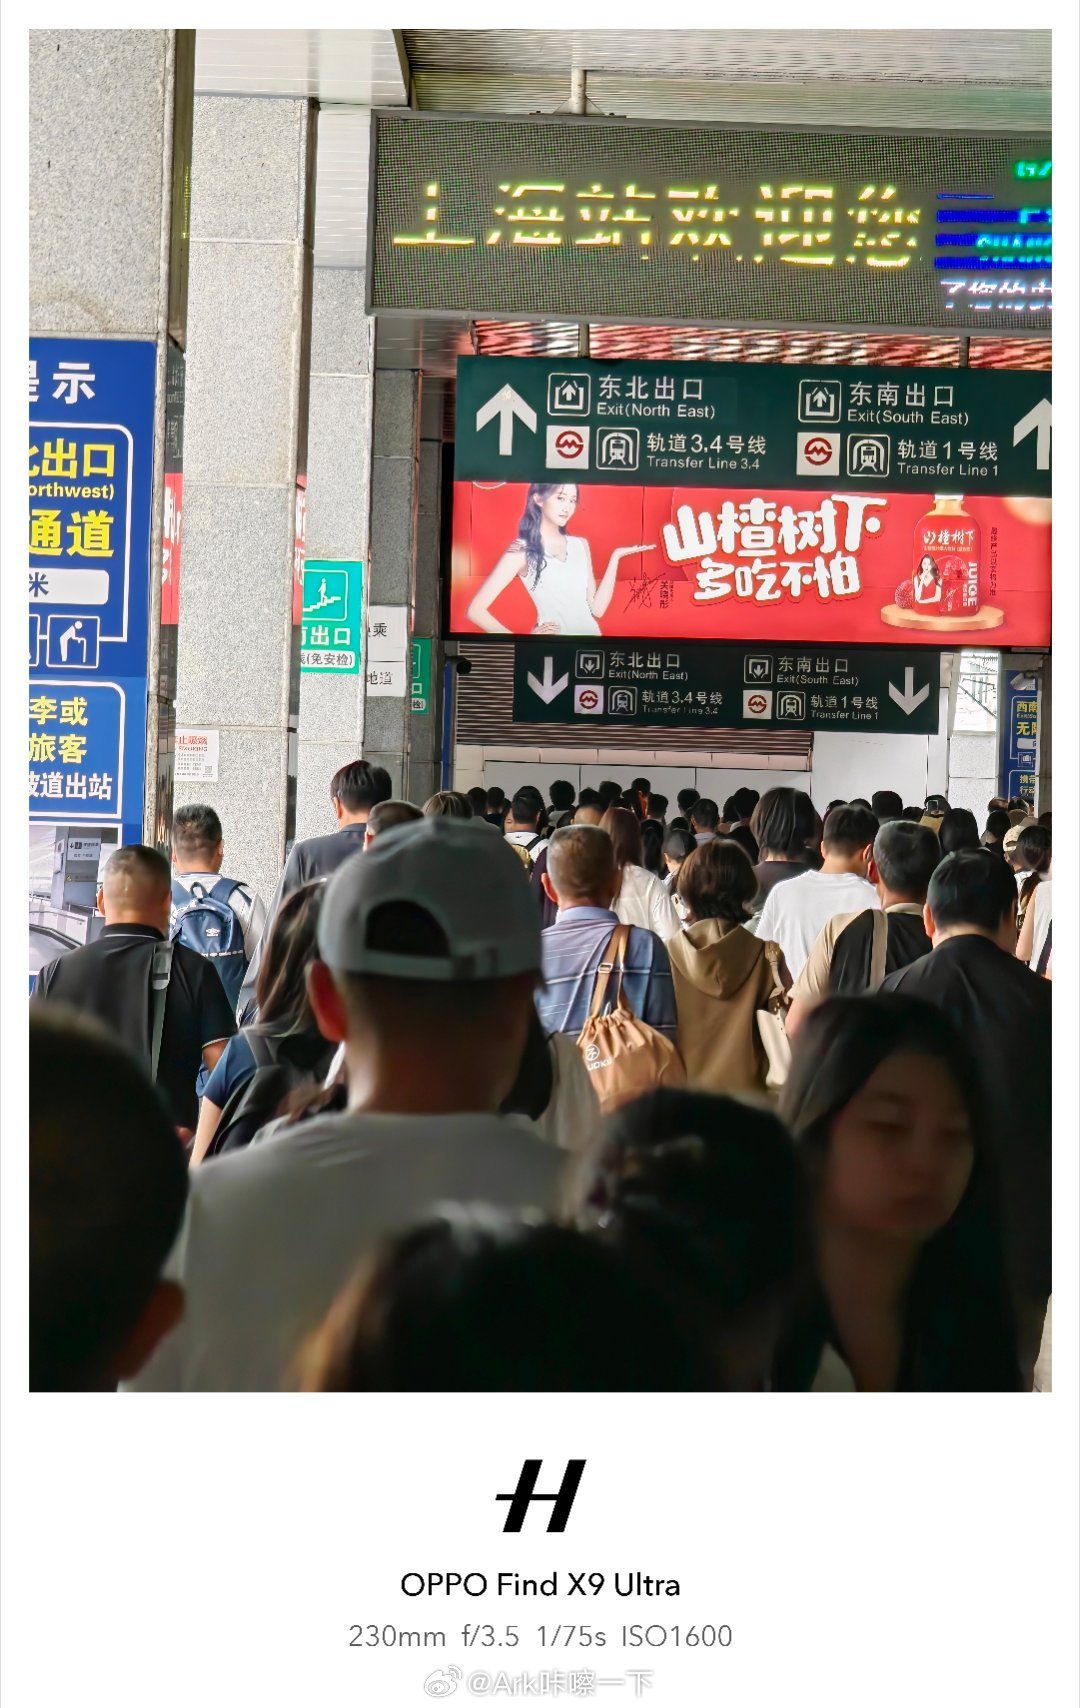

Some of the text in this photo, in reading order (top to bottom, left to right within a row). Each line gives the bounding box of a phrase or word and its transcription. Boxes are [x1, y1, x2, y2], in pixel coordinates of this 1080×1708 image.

[29, 360, 96, 405] 示
[598, 375, 704, 401] 东北出口
[849, 381, 955, 407] 东南出口
[597, 403, 716, 420] Exit(North East)
[847, 409, 969, 427] Exit(South East)
[897, 439, 998, 461] 轨道1号线
[647, 455, 704, 469] Transfer
[709, 457, 737, 469] Line
[897, 462, 999, 477] Transfer Line 1
[29, 509, 115, 557] 通道
[663, 494, 888, 562] 山楂树下
[29, 572, 49, 598] 米
[693, 551, 861, 601] 多吃不怕
[368, 622, 388, 638] 乘
[609, 651, 681, 669] 东北出口
[778, 656, 849, 674] 东南出口
[608, 669, 689, 681] Exit(North East)
[776, 674, 860, 687] Exit(South East)
[29, 695, 88, 726] 李或
[810, 695, 879, 710] 轨道1号线
[811, 709, 879, 720] Transfer Line 1
[29, 732, 88, 763] 旅客
